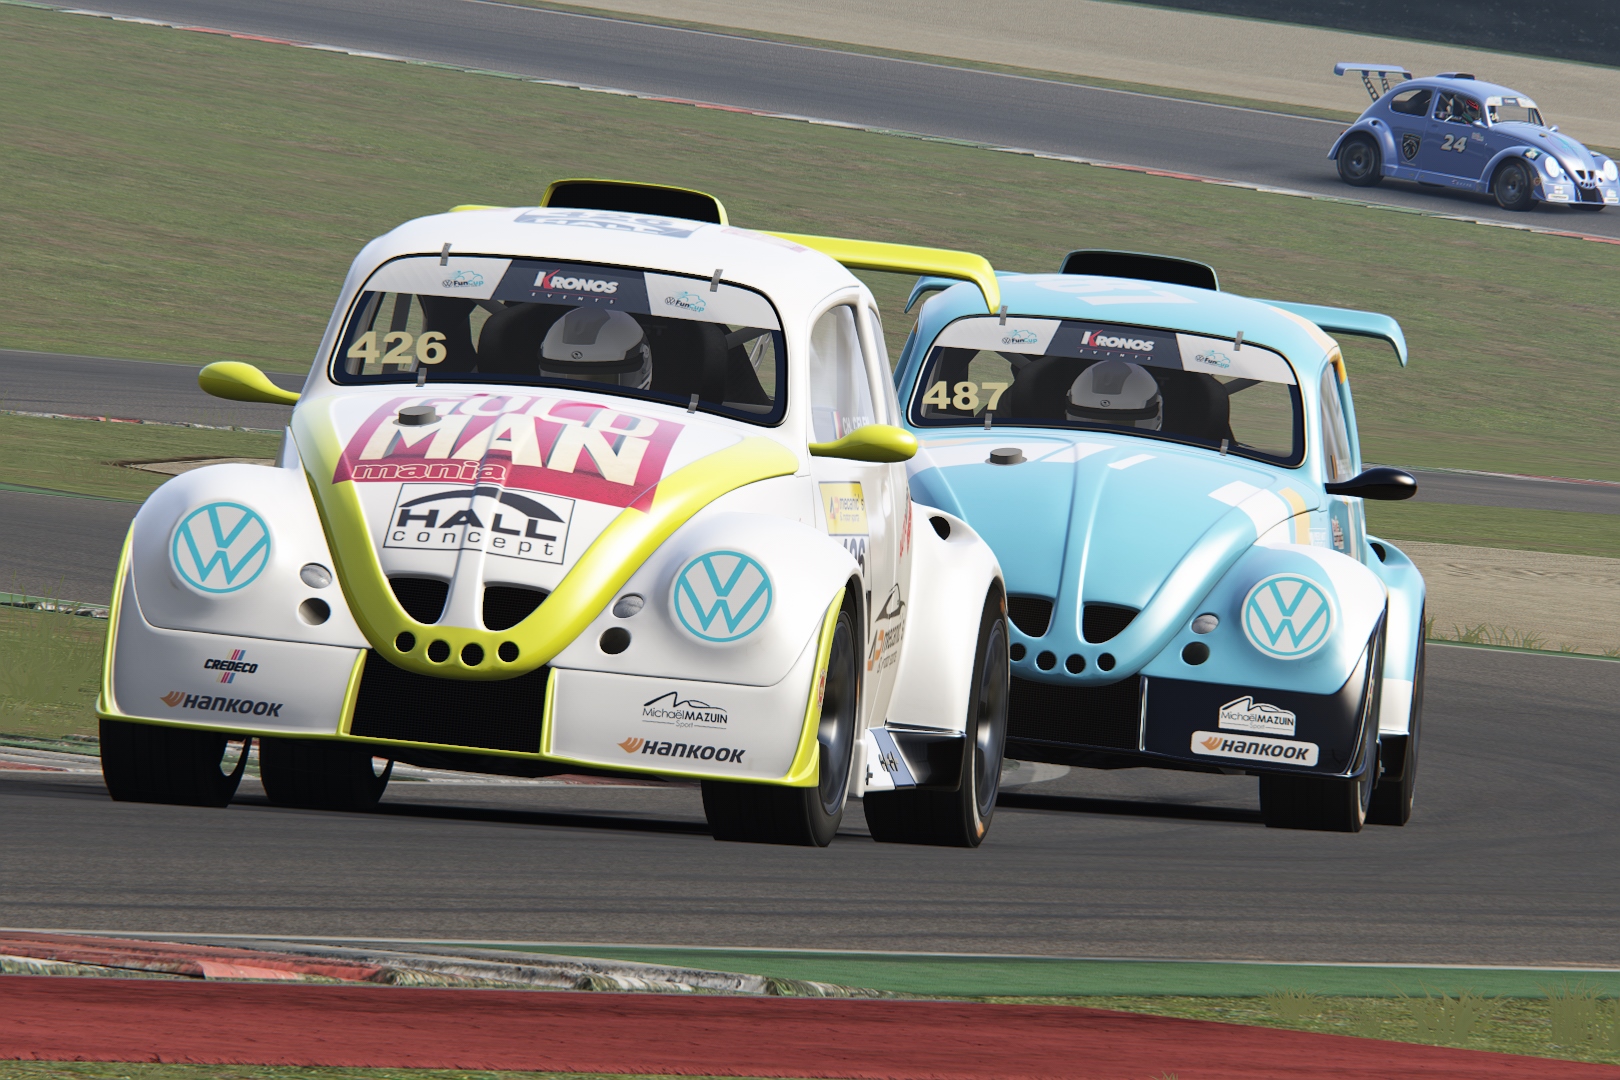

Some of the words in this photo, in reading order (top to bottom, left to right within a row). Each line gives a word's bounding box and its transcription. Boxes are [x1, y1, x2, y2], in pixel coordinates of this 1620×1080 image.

[1440, 133, 1468, 153] 24
[533, 268, 619, 294] KRONOS
[346, 331, 447, 365] 426
[1080, 329, 1155, 352] KRONOS
[922, 380, 1009, 411] 487
[359, 412, 650, 486] MAN
[352, 460, 507, 481] mania
[396, 508, 557, 542] HALL
[392, 530, 554, 556] concept
[203, 658, 259, 674] CREDECO
[675, 720, 694, 729] Sport
